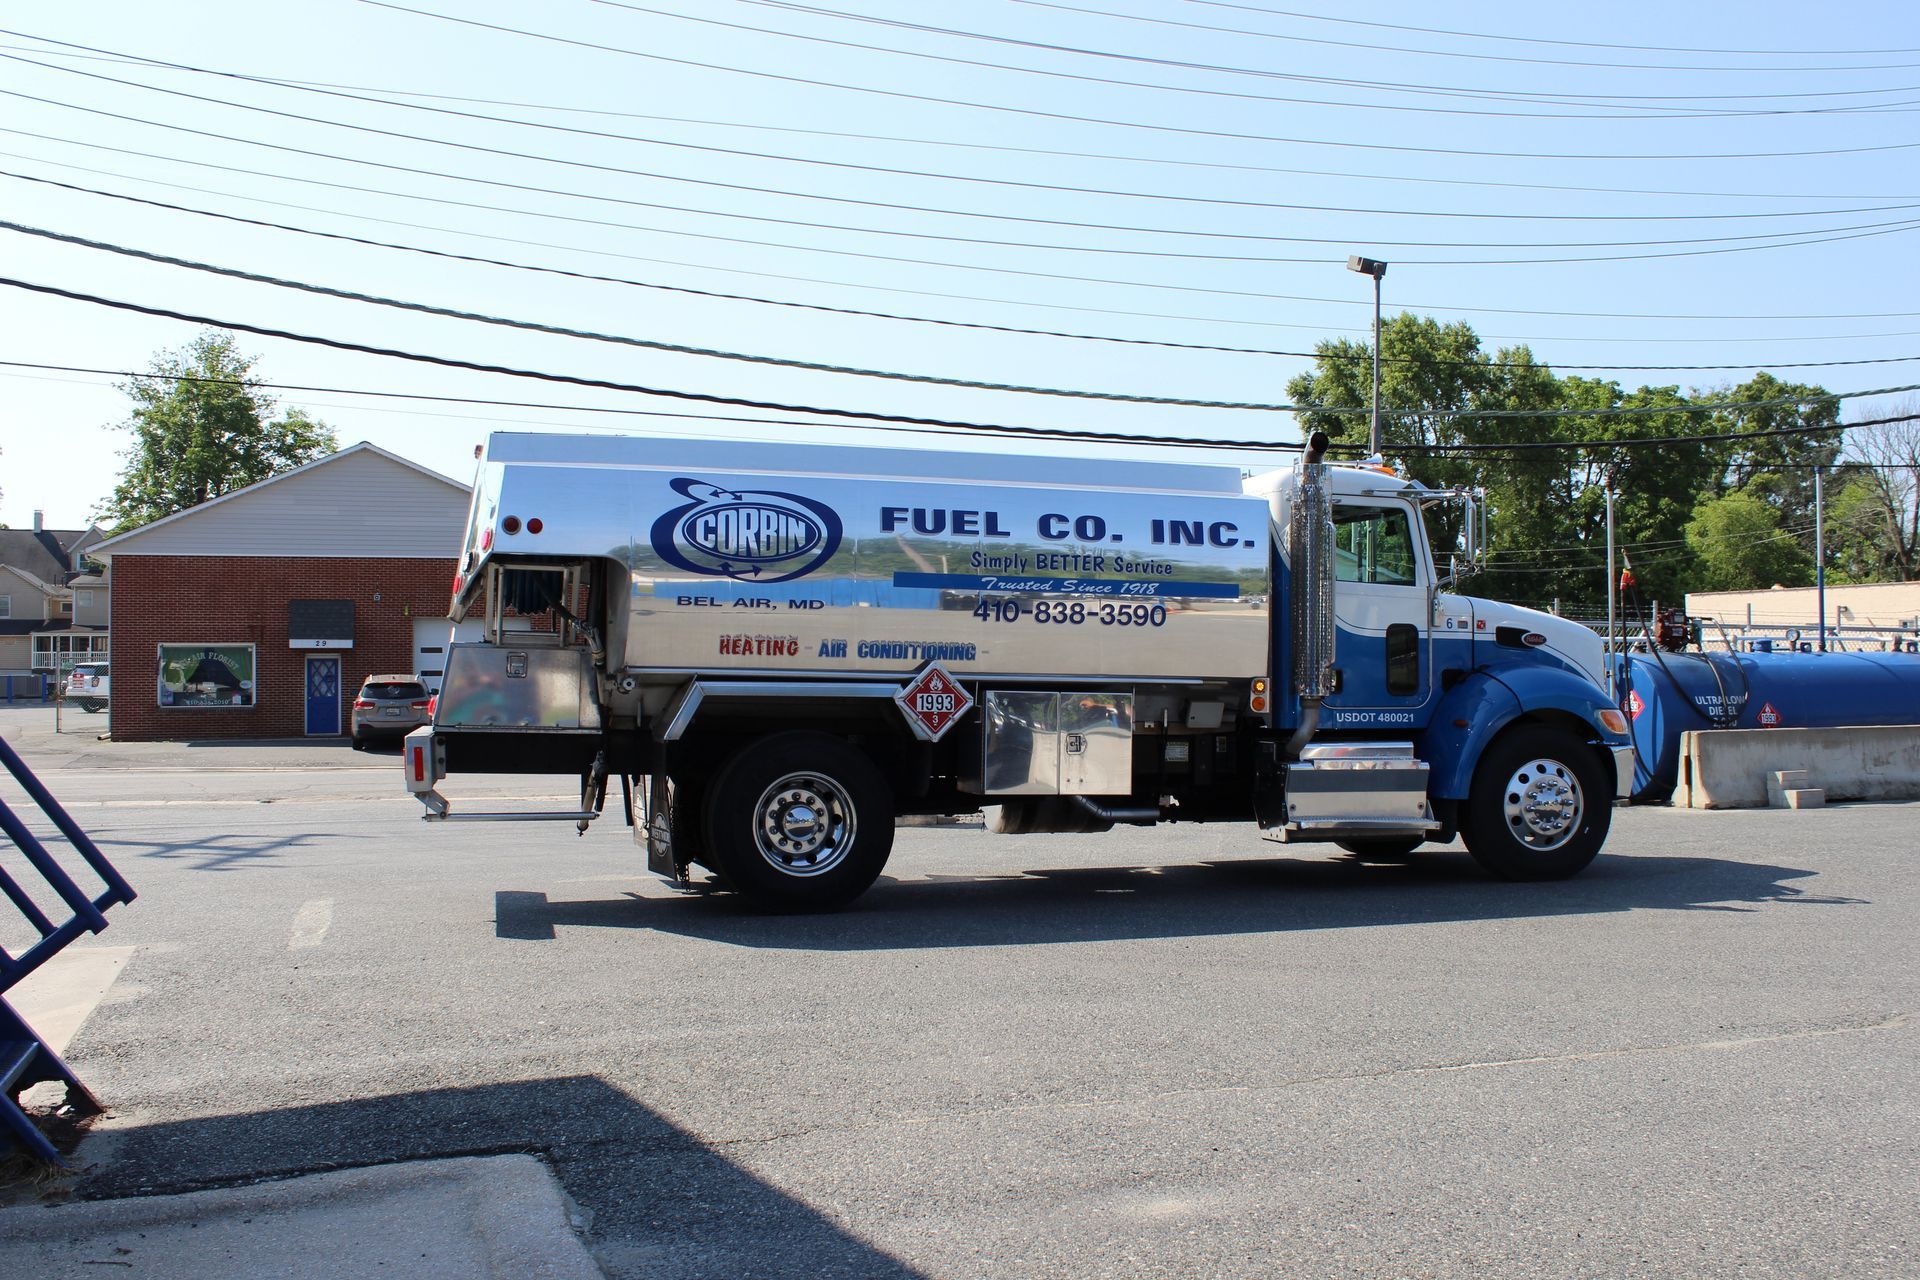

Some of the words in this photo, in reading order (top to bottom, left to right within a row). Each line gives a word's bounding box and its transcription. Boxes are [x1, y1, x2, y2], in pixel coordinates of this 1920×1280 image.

[695, 508, 806, 558] CORBIN
[879, 506, 1010, 537] FUEL
[1037, 512, 1123, 542] CO.
[1151, 518, 1256, 548] INC.
[970, 551, 1027, 574] Simply
[1035, 553, 1105, 573] BETTER
[1113, 556, 1173, 576] Service
[981, 576, 1052, 591] Trusted
[1060, 580, 1112, 594] Since
[1120, 582, 1158, 595] 1918
[677, 595, 722, 607] BEL
[733, 597, 777, 611] AIR,
[788, 599, 825, 610] MD
[973, 600, 1167, 627] 410-838-3590
[1446, 617, 1453, 629] 6
[719, 636, 799, 656] HEATING
[818, 638, 848, 658] AIR
[857, 639, 976, 661] CONDITIONING
[208, 652, 239, 670] FLORIST
[918, 694, 954, 711] 1993
[1695, 696, 1723, 705] ULTRA
[1726, 695, 1745, 704] LOW
[932, 714, 939, 724] 3
[1336, 712, 1376, 722] USDOT
[1378, 713, 1414, 723] 480021
